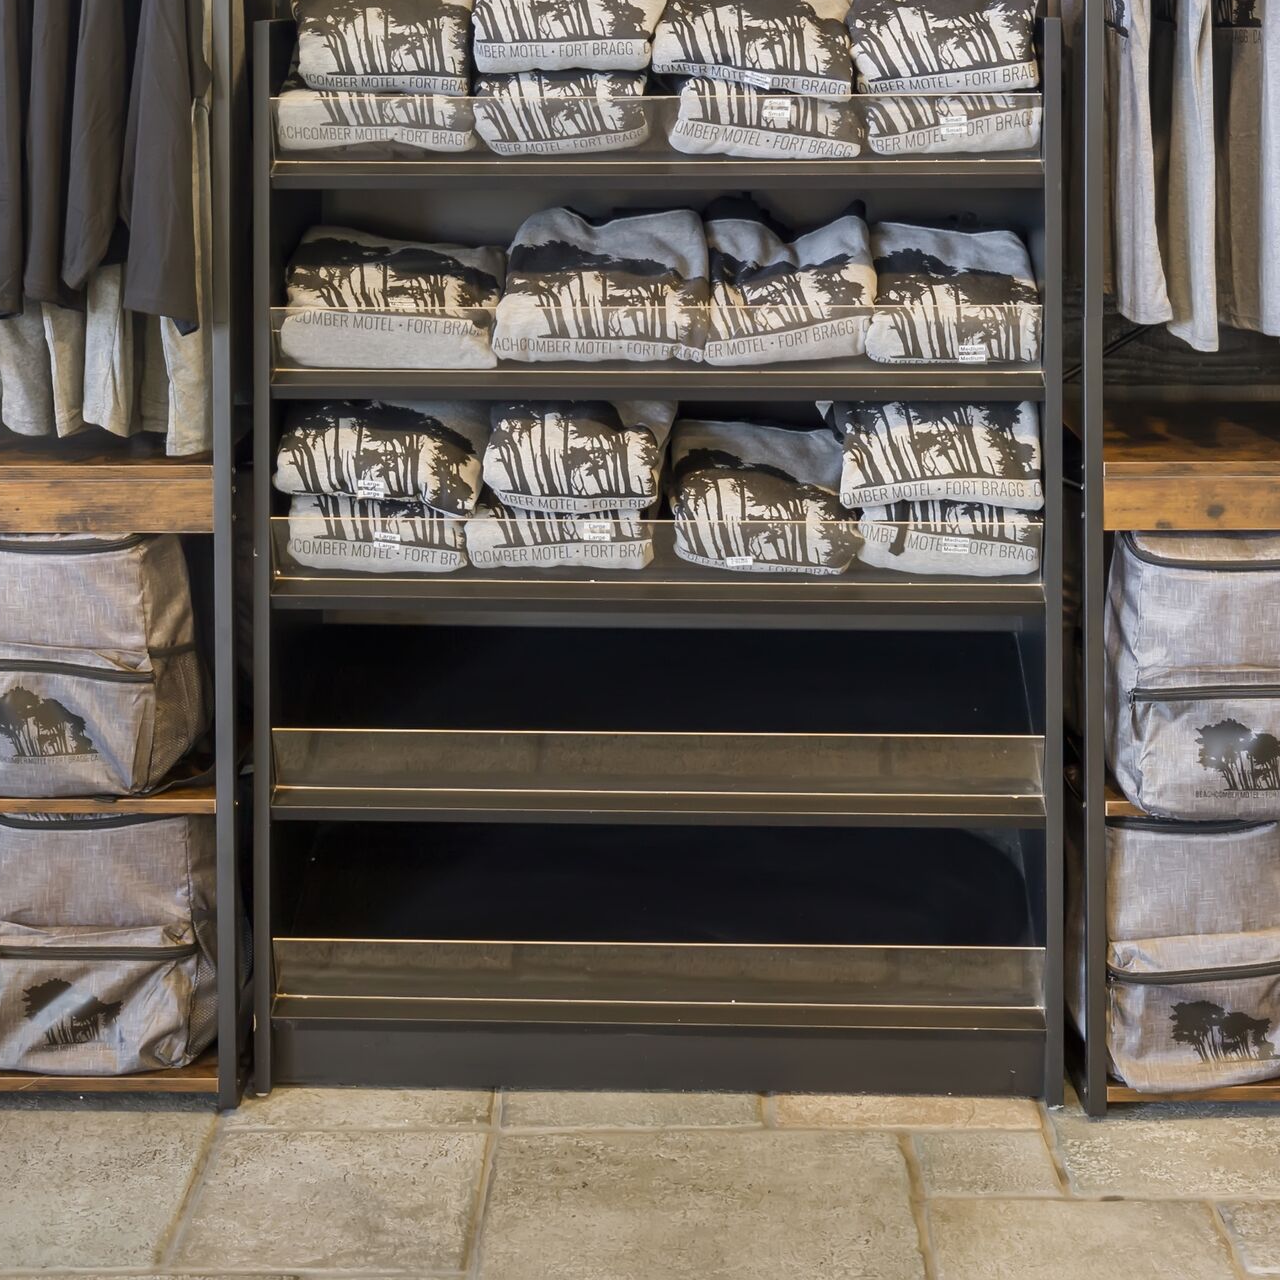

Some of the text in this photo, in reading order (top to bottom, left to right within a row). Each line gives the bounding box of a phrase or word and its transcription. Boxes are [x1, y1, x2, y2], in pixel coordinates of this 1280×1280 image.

[510, 45, 547, 58] MOTEL
[560, 43, 589, 56] FORT
[593, 42, 633, 56] BRAGG
[361, 77, 397, 88] MOTEL
[409, 78, 438, 89] FORT
[711, 66, 744, 81] MOTE
[772, 77, 799, 88] ORT
[802, 81, 847, 95] BRAGG
[909, 78, 953, 90] MOTEL
[964, 71, 997, 86] FORT
[355, 128, 389, 140] MOTEL
[401, 130, 429, 143] FORT
[722, 130, 761, 146] MOTEL
[773, 135, 804, 151] FORT
[808, 140, 853, 157] BRAGG
[905, 130, 947, 150] MOTEL
[525, 142, 561, 153] MOTEL
[573, 137, 602, 149] FORT
[352, 317, 394, 331] MOTEL
[407, 319, 441, 334] FORT
[727, 338, 767, 356] MOTEL
[778, 329, 809, 348] FORT
[813, 320, 854, 341] BRAGG
[574, 341, 613, 354] MOTEL
[627, 343, 658, 354] FORT
[892, 486, 933, 500] MOTEL
[946, 481, 979, 496] FORT
[982, 481, 1024, 497] BRAGG
[592, 499, 623, 509] FORT
[291, 538, 347, 556] COMBER
[351, 545, 392, 560] MOTEL
[405, 547, 434, 563] FORT
[531, 547, 570, 561] MOTEL
[584, 545, 615, 557] FORT
[908, 535, 942, 551] MOTE
[970, 542, 994, 557] ORT
